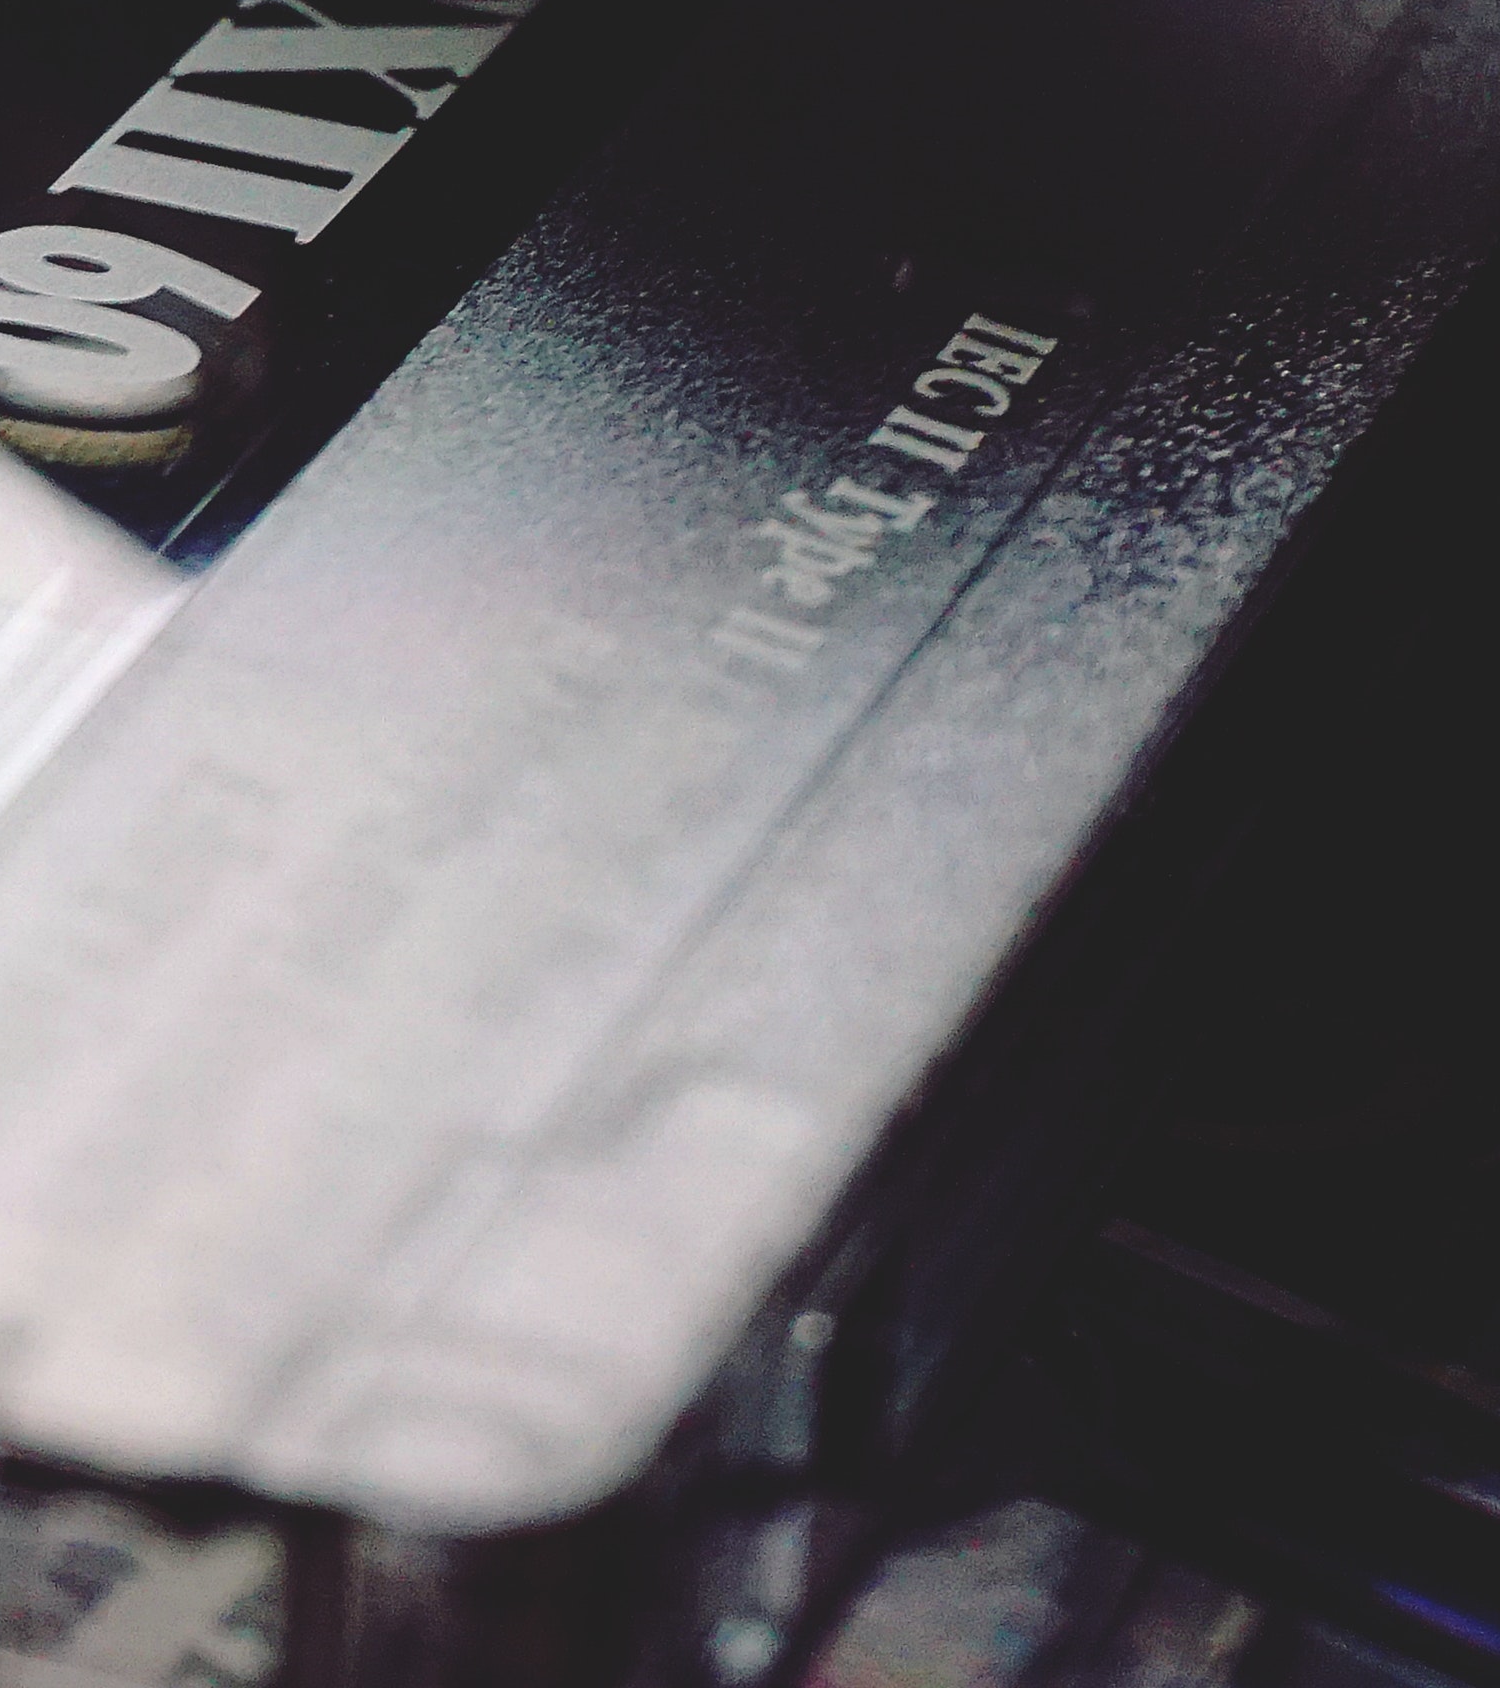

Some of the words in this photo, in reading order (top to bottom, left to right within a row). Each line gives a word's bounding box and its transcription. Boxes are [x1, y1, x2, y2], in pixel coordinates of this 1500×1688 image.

[912, 312, 1058, 417] IEC
[867, 404, 986, 473] II
[758, 474, 938, 608] Type
